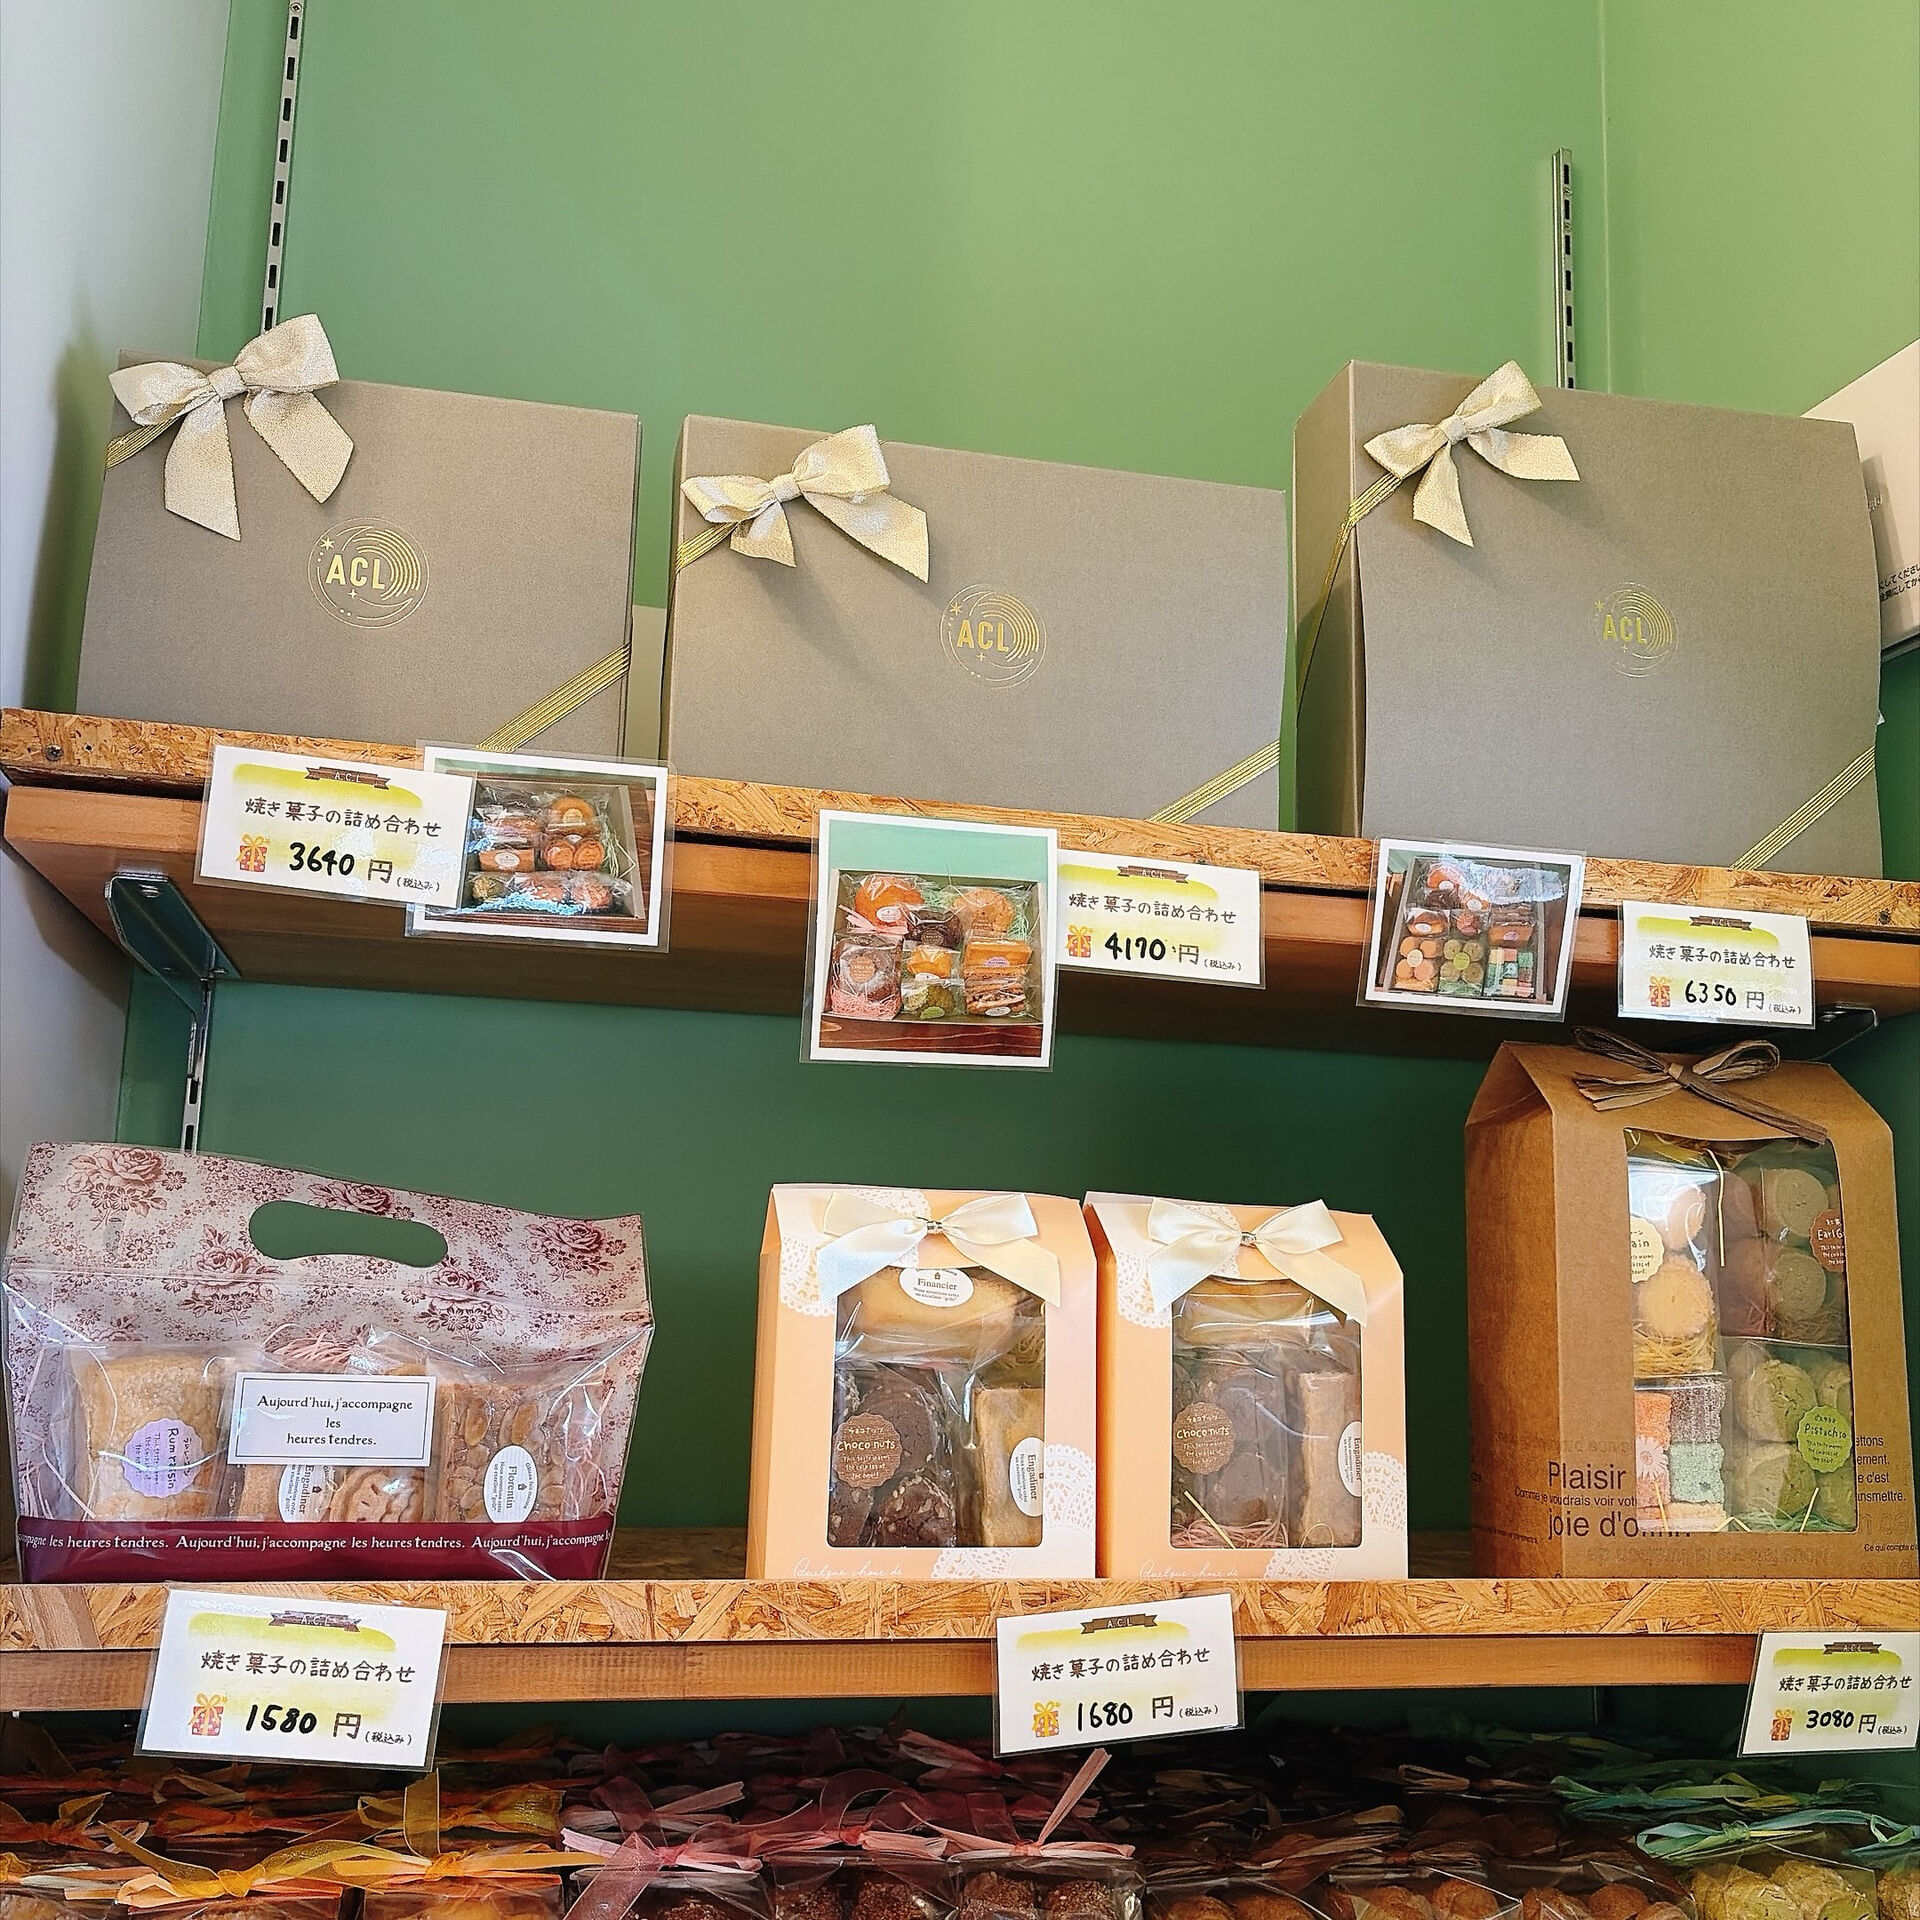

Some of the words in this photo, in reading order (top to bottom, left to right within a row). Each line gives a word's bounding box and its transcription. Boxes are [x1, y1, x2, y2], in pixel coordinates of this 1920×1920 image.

[325, 554, 386, 590] ACL
[957, 619, 1010, 652] ACL
[1602, 614, 1648, 644] ACL
[245, 797, 442, 839] 焼き菓子の詰め合わせ
[288, 841, 355, 876] 3640
[367, 858, 394, 885] 円
[1068, 892, 1237, 924] 焼き菓子の詰め合わせ
[1104, 932, 1166, 961] 4170
[1178, 944, 1200, 965] 円
[1649, 944, 1796, 969] 焼き菓子の詰め合わせ
[1684, 980, 1737, 1006] 6350
[1746, 991, 1764, 1010] 円
[1631, 1240, 1650, 1248] ain
[1817, 1229, 1836, 1241] Earl
[1836, 1229, 1843, 1239] G
[917, 1278, 958, 1291] Financier
[257, 1395, 334, 1410] Aujourd'hui,
[335, 1397, 413, 1413] j'accompagne
[326, 1417, 341, 1429] les
[1804, 1423, 1847, 1439] Pistachio
[168, 1428, 179, 1453] Rum
[287, 1433, 326, 1445] heures
[329, 1434, 377, 1446] tendres.
[1857, 1454, 1890, 1465] ement.
[299, 1465, 315, 1514] Engadiner
[507, 1466, 517, 1509] Florentin
[1026, 1454, 1038, 1500] Engadiner
[1548, 1461, 1627, 1489] Plaisir
[1858, 1474, 1864, 1483] e
[1866, 1473, 1890, 1483] c'est
[1514, 1486, 1540, 1501] Comme
[1549, 1495, 1591, 1506] voudrais
[1594, 1496, 1614, 1506] voir
[1548, 1508, 1589, 1540] joie
[49, 1534, 64, 1547] les
[67, 1535, 111, 1549] heures
[114, 1535, 169, 1549] tendres.
[175, 1535, 260, 1552] Aujourd'hui,
[260, 1535, 347, 1552] j'accompagne
[351, 1537, 368, 1549] les
[371, 1537, 413, 1549] heures
[415, 1536, 466, 1549] tendres.
[471, 1536, 544, 1551] Aujourd'hui,
[545, 1533, 604, 1550] j'accompagne
[200, 1649, 416, 1684] 焼き菓子の詰め合わせ
[1031, 1648, 1211, 1682] 焼き菓子の詰め合わせ
[1778, 1674, 1913, 1692] 焼き菓子の詰め合わせ
[245, 1704, 318, 1735] 1580
[333, 1712, 362, 1740] 円
[1077, 1702, 1133, 1732] 1680
[1152, 1695, 1174, 1720] 円
[1805, 1709, 1855, 1729] 3080
[1858, 1714, 1877, 1734] 円
